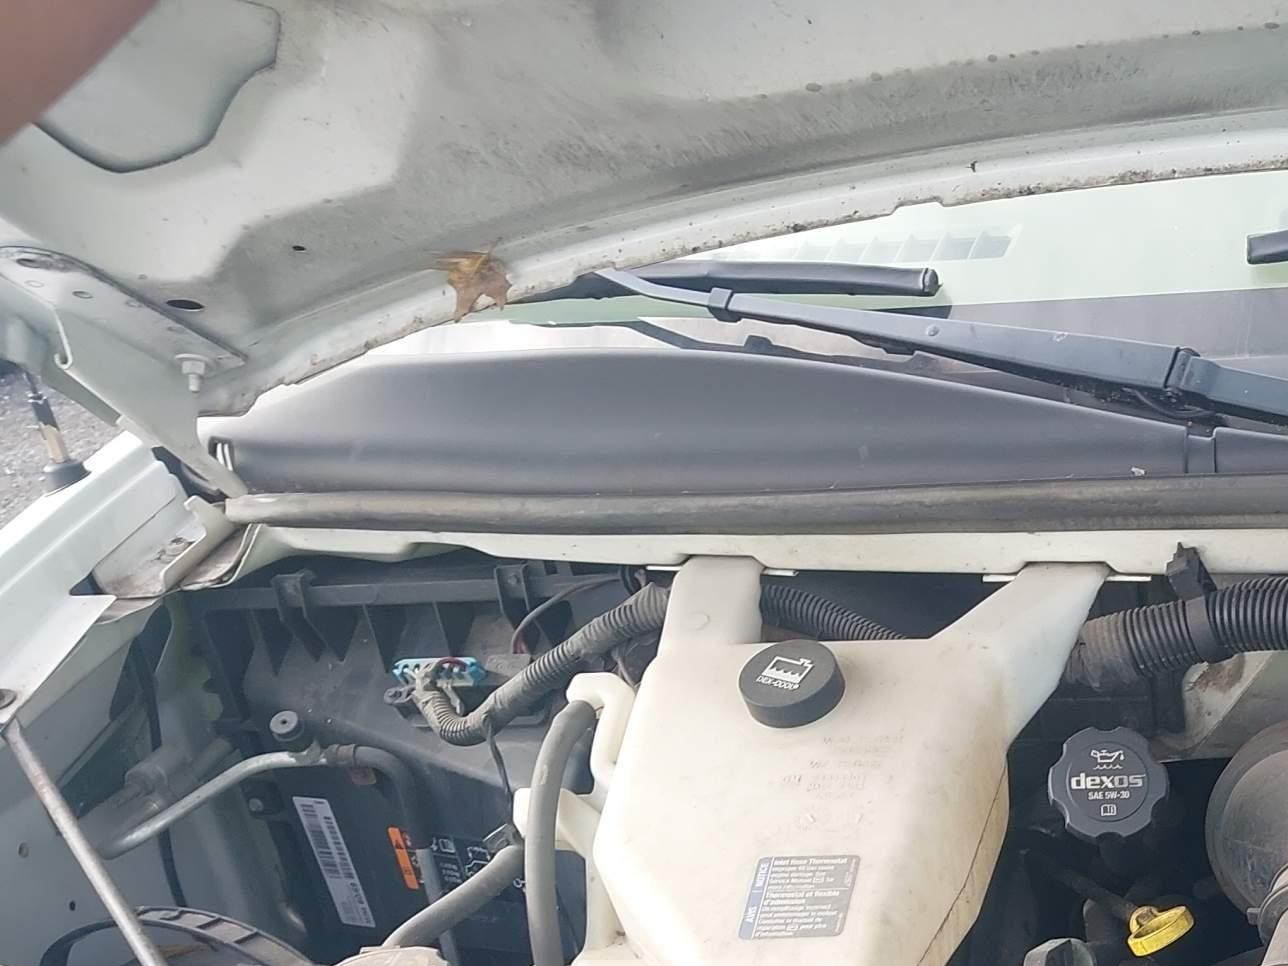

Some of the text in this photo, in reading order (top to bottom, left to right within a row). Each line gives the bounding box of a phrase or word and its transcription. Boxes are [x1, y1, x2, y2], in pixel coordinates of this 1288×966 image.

[1070, 772, 1146, 790] dexos
[1088, 790, 1130, 800] SAE 5W-30
